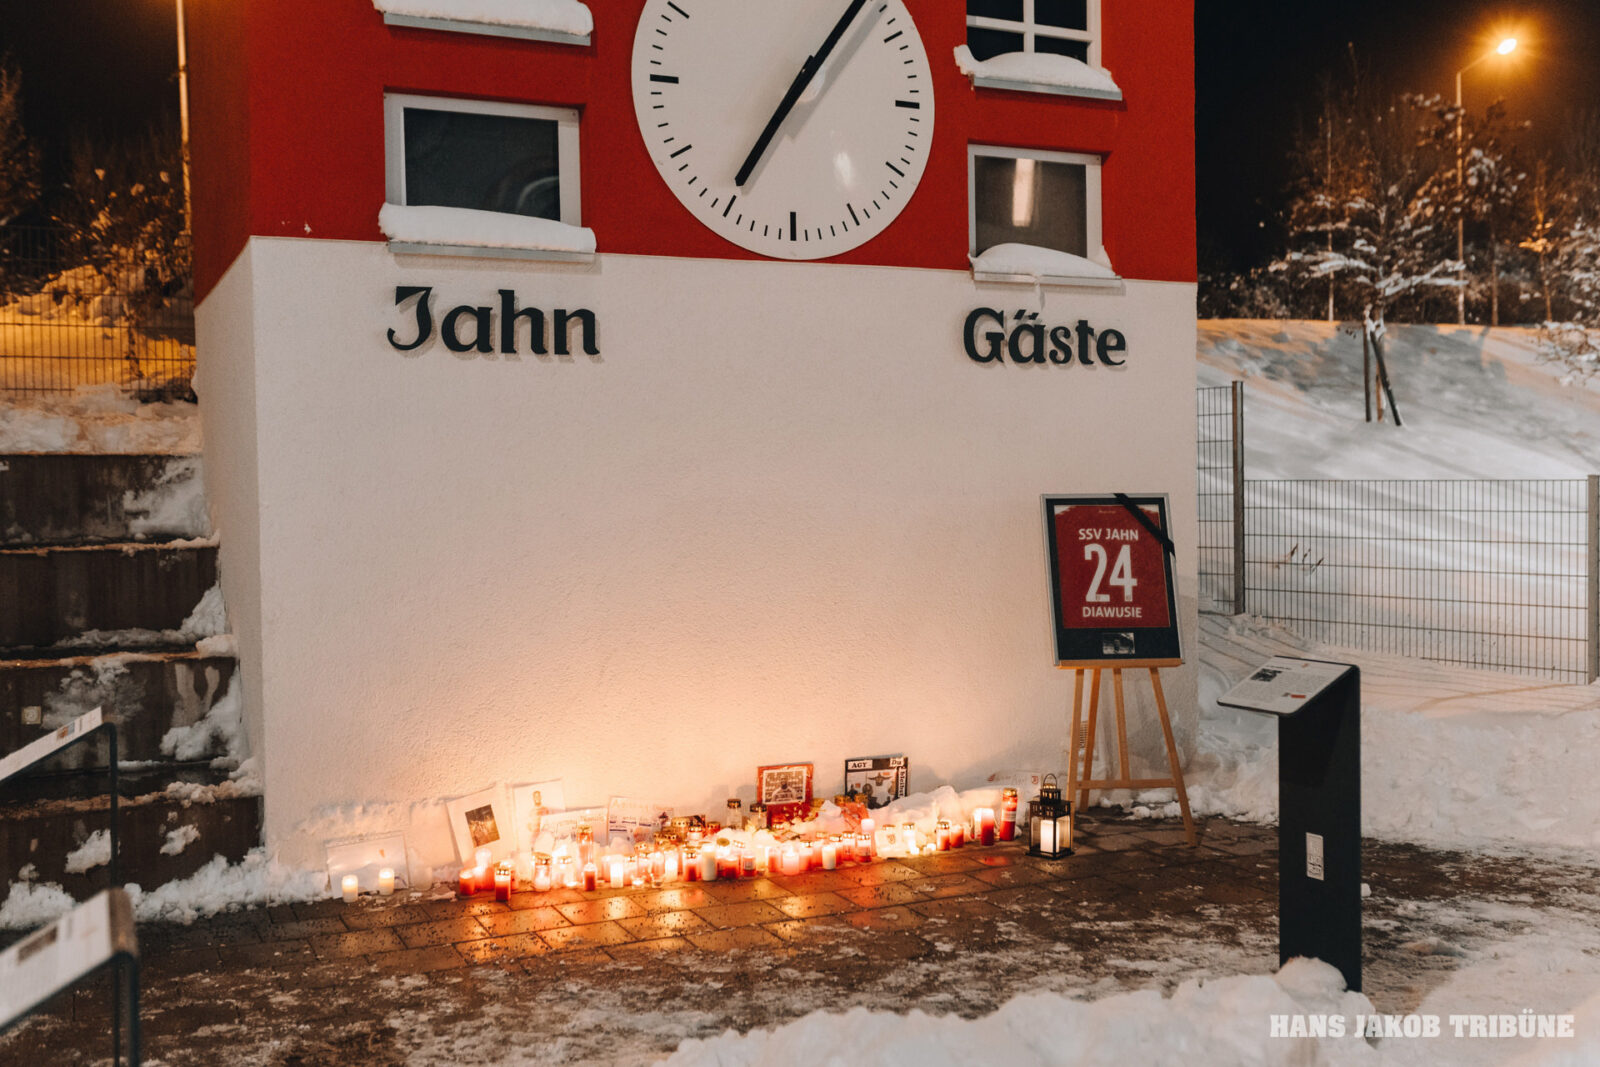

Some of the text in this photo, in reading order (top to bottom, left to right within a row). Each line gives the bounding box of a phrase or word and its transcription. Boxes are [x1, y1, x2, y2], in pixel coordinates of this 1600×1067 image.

[387, 286, 600, 355] Jahn
[963, 307, 1126, 365] Gäste
[1079, 528, 1138, 541] SSV JAHN
[1084, 543, 1138, 602] 24
[1082, 606, 1142, 618] DIAWUSIE
